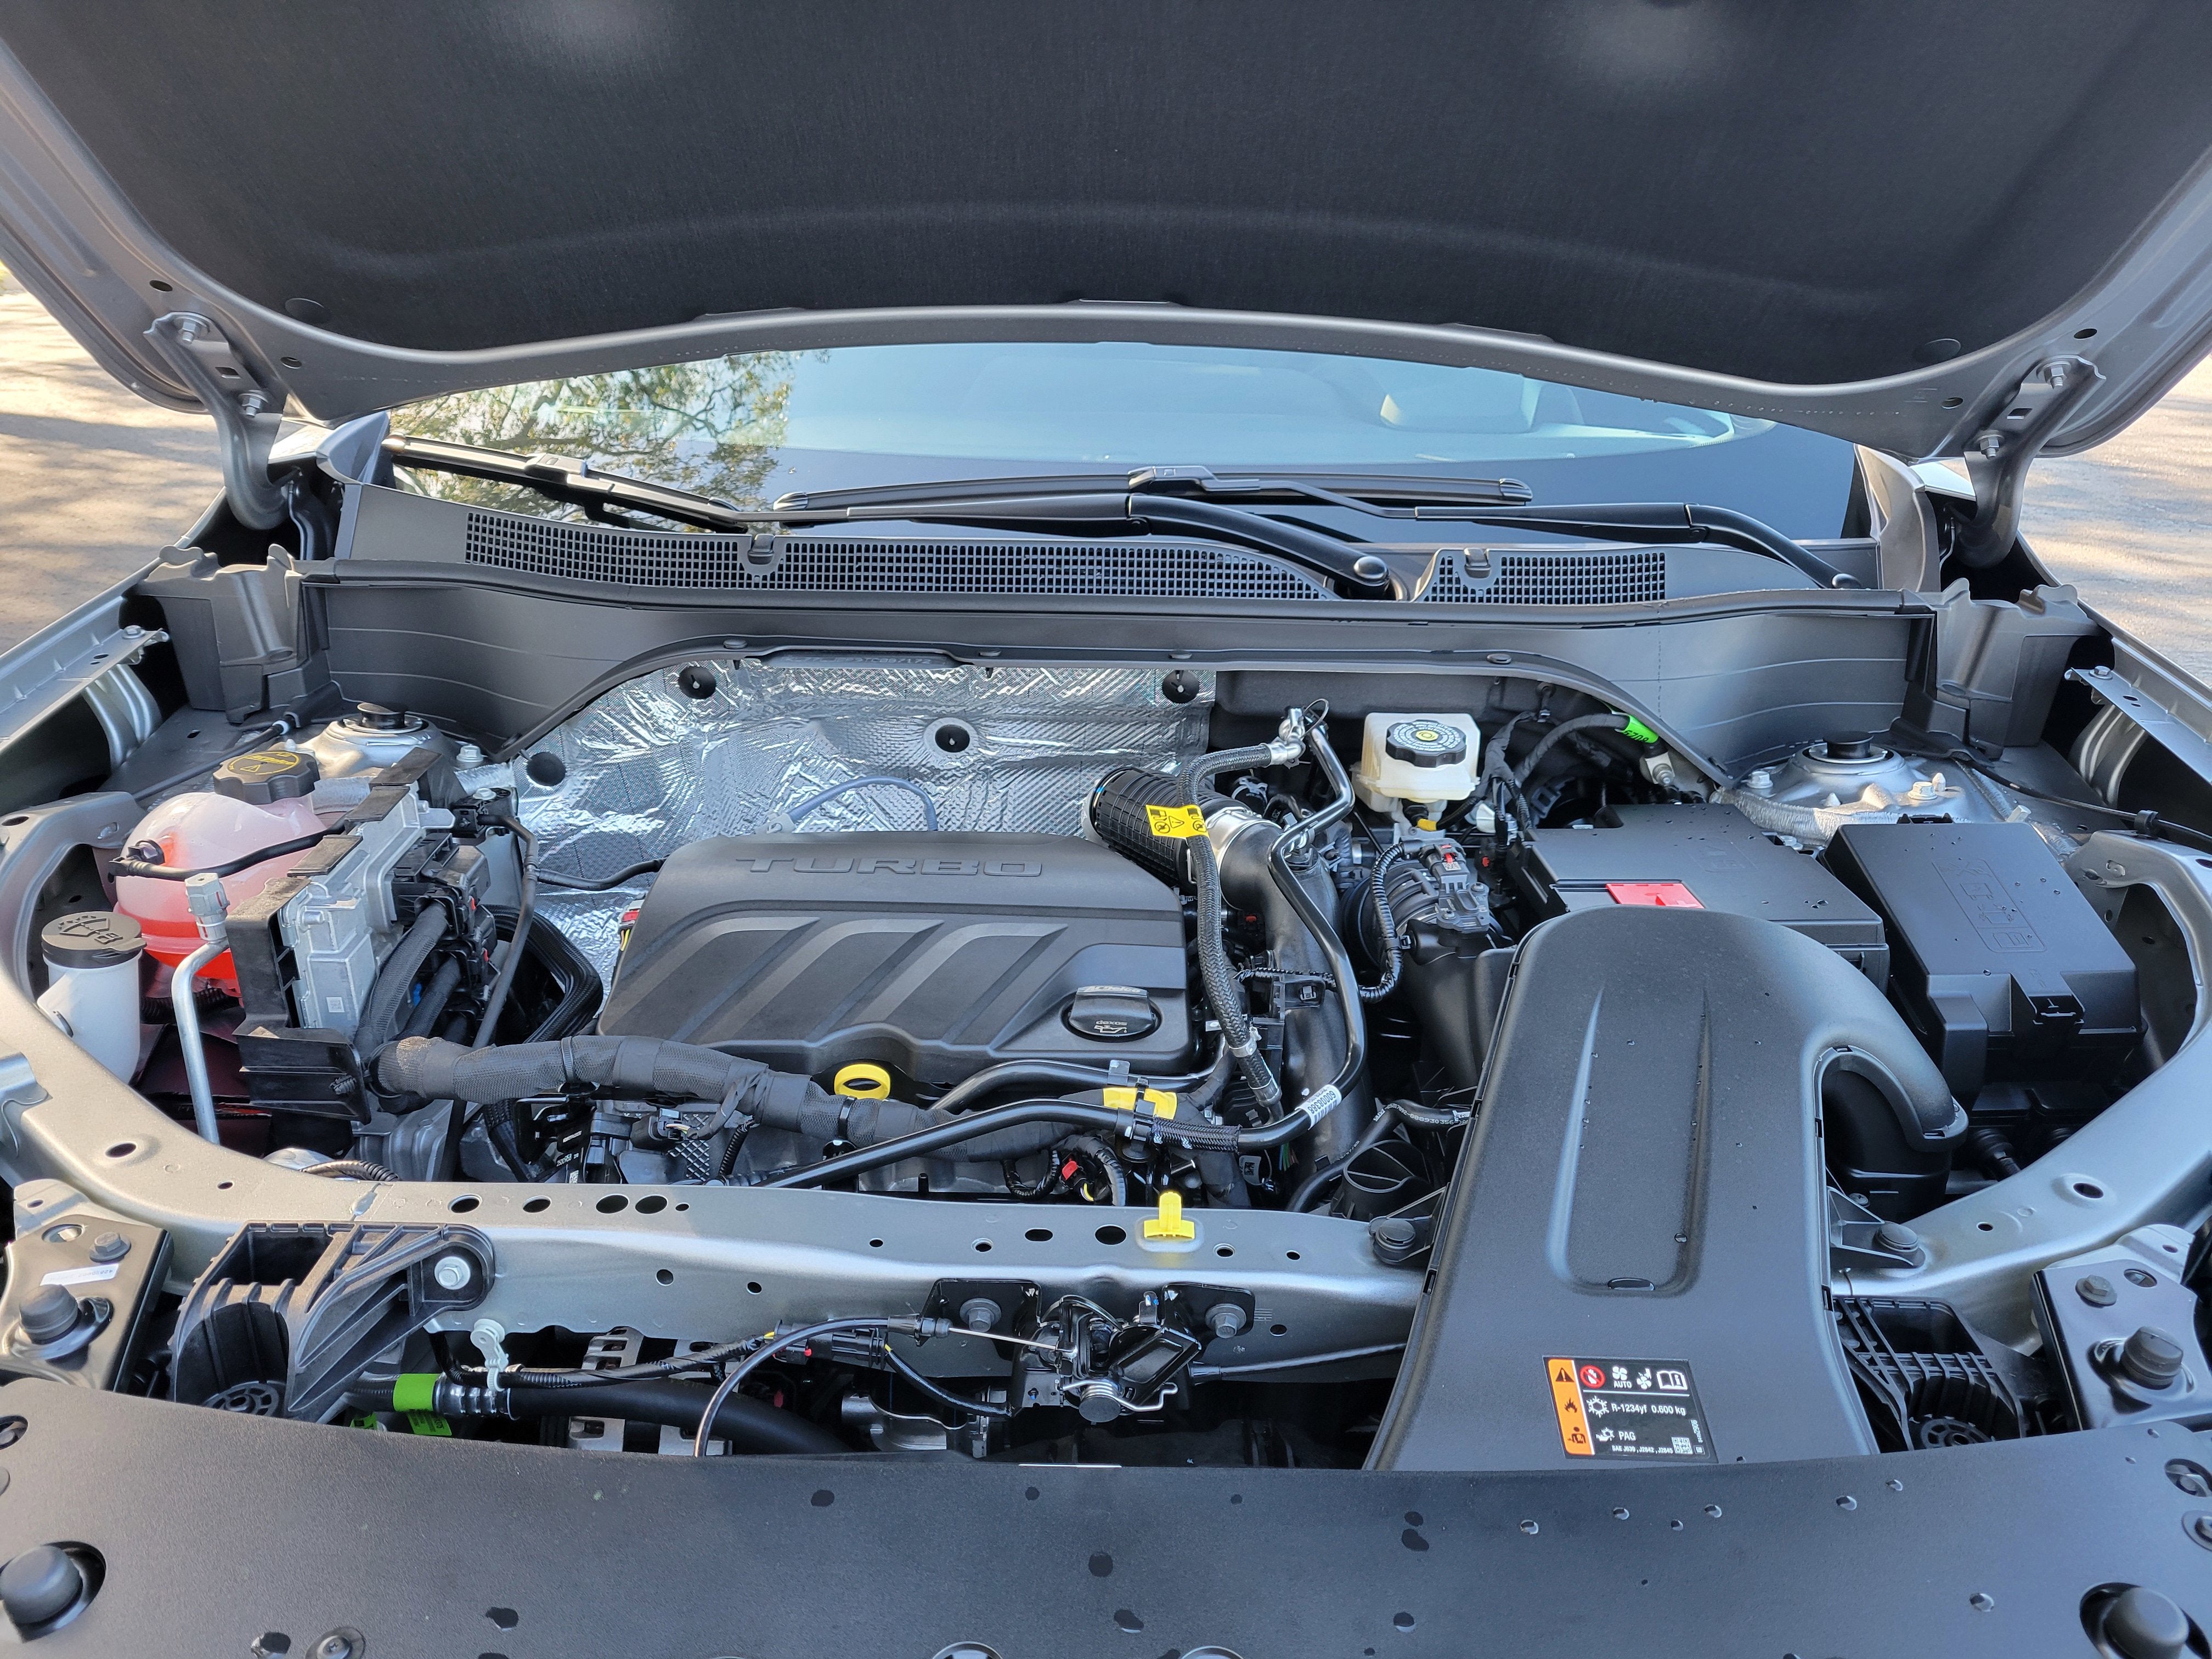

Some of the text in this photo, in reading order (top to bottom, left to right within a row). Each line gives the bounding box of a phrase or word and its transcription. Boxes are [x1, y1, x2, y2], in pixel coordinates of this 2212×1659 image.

[736, 857, 1043, 877] TURBO
[1084, 985, 1141, 994] ACDelco
[1611, 1403, 1686, 1416] R-1234yf 0.600 kg
[1618, 1431, 1636, 1441] PAG
